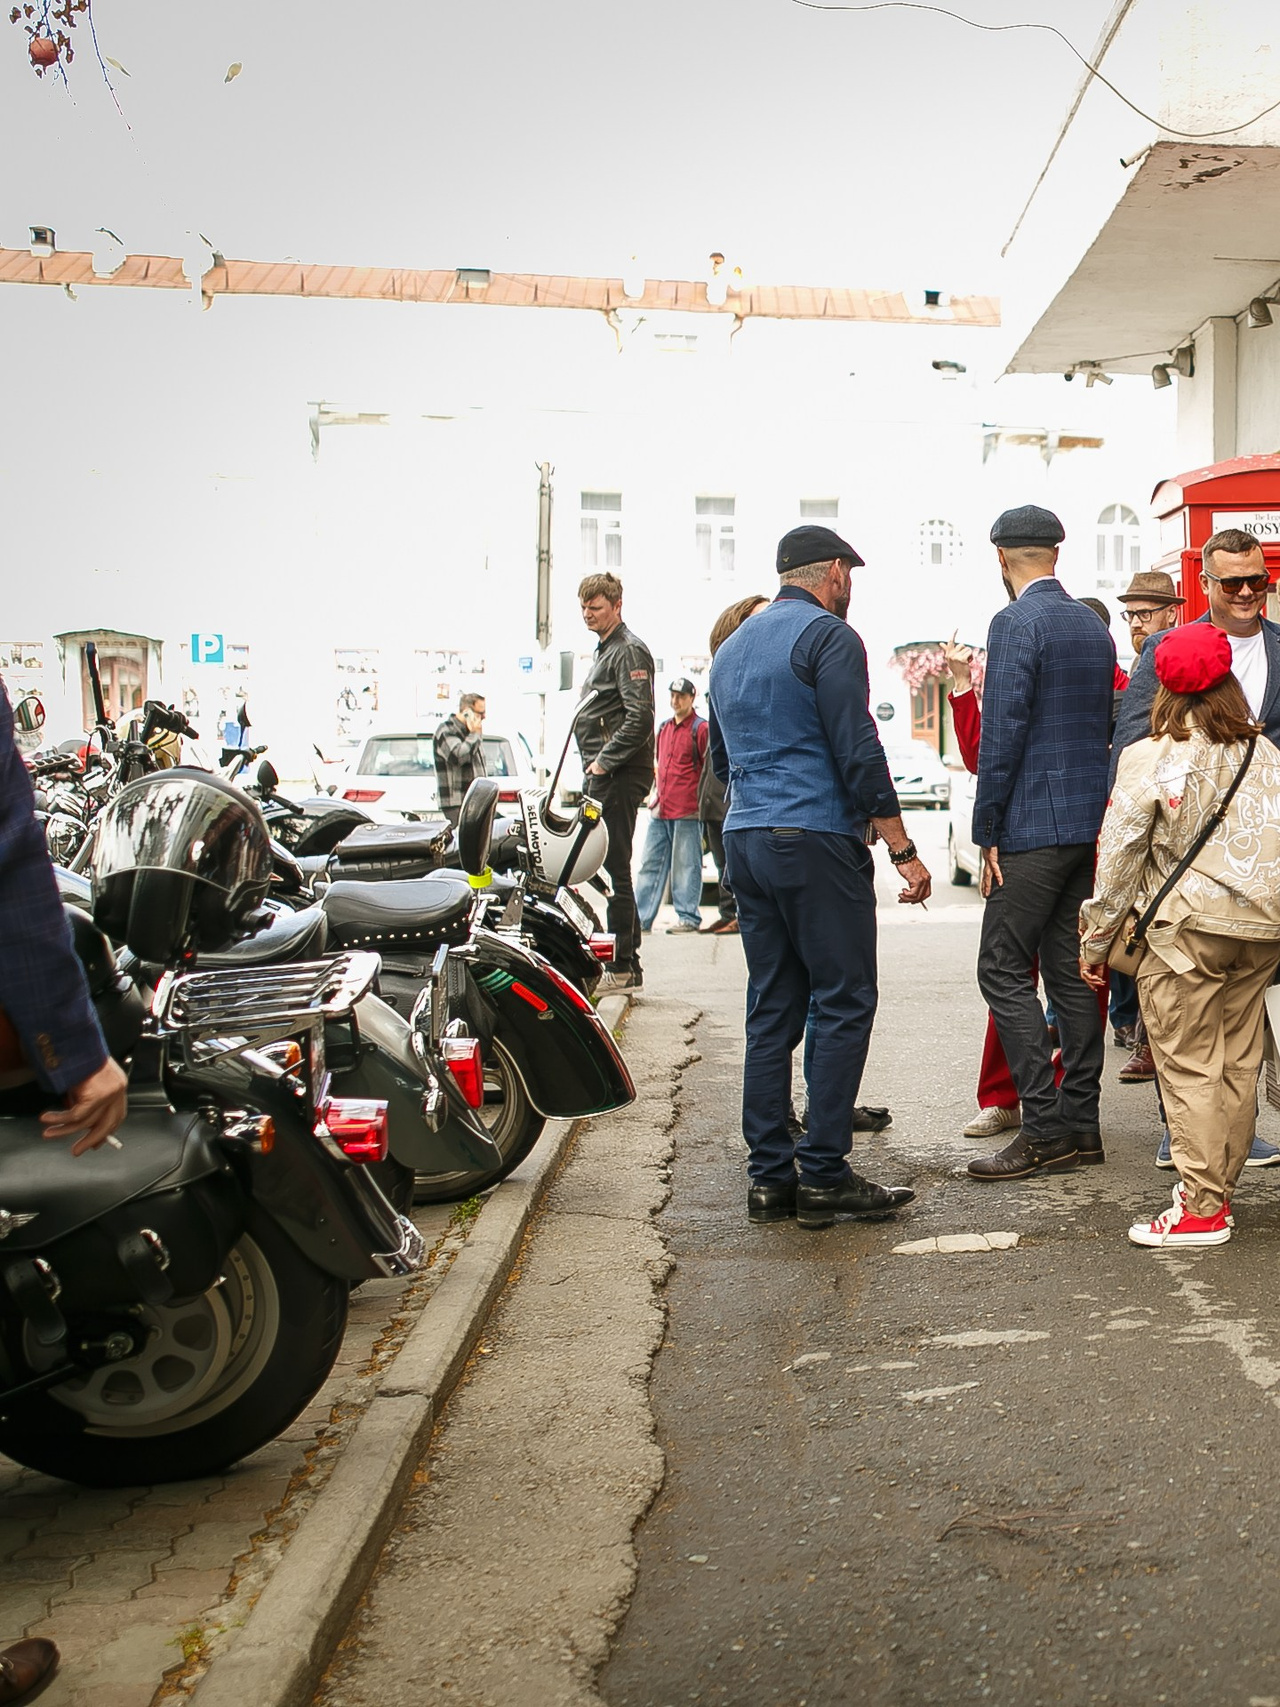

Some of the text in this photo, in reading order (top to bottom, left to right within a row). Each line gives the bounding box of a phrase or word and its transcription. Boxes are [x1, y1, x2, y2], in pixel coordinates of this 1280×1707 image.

[1243, 522, 1280, 536] ROSY
[1255, 513, 1265, 521] The
[198, 634, 220, 664] P
[526, 804, 539, 829] BELL
[530, 830, 543, 864] MOTO
